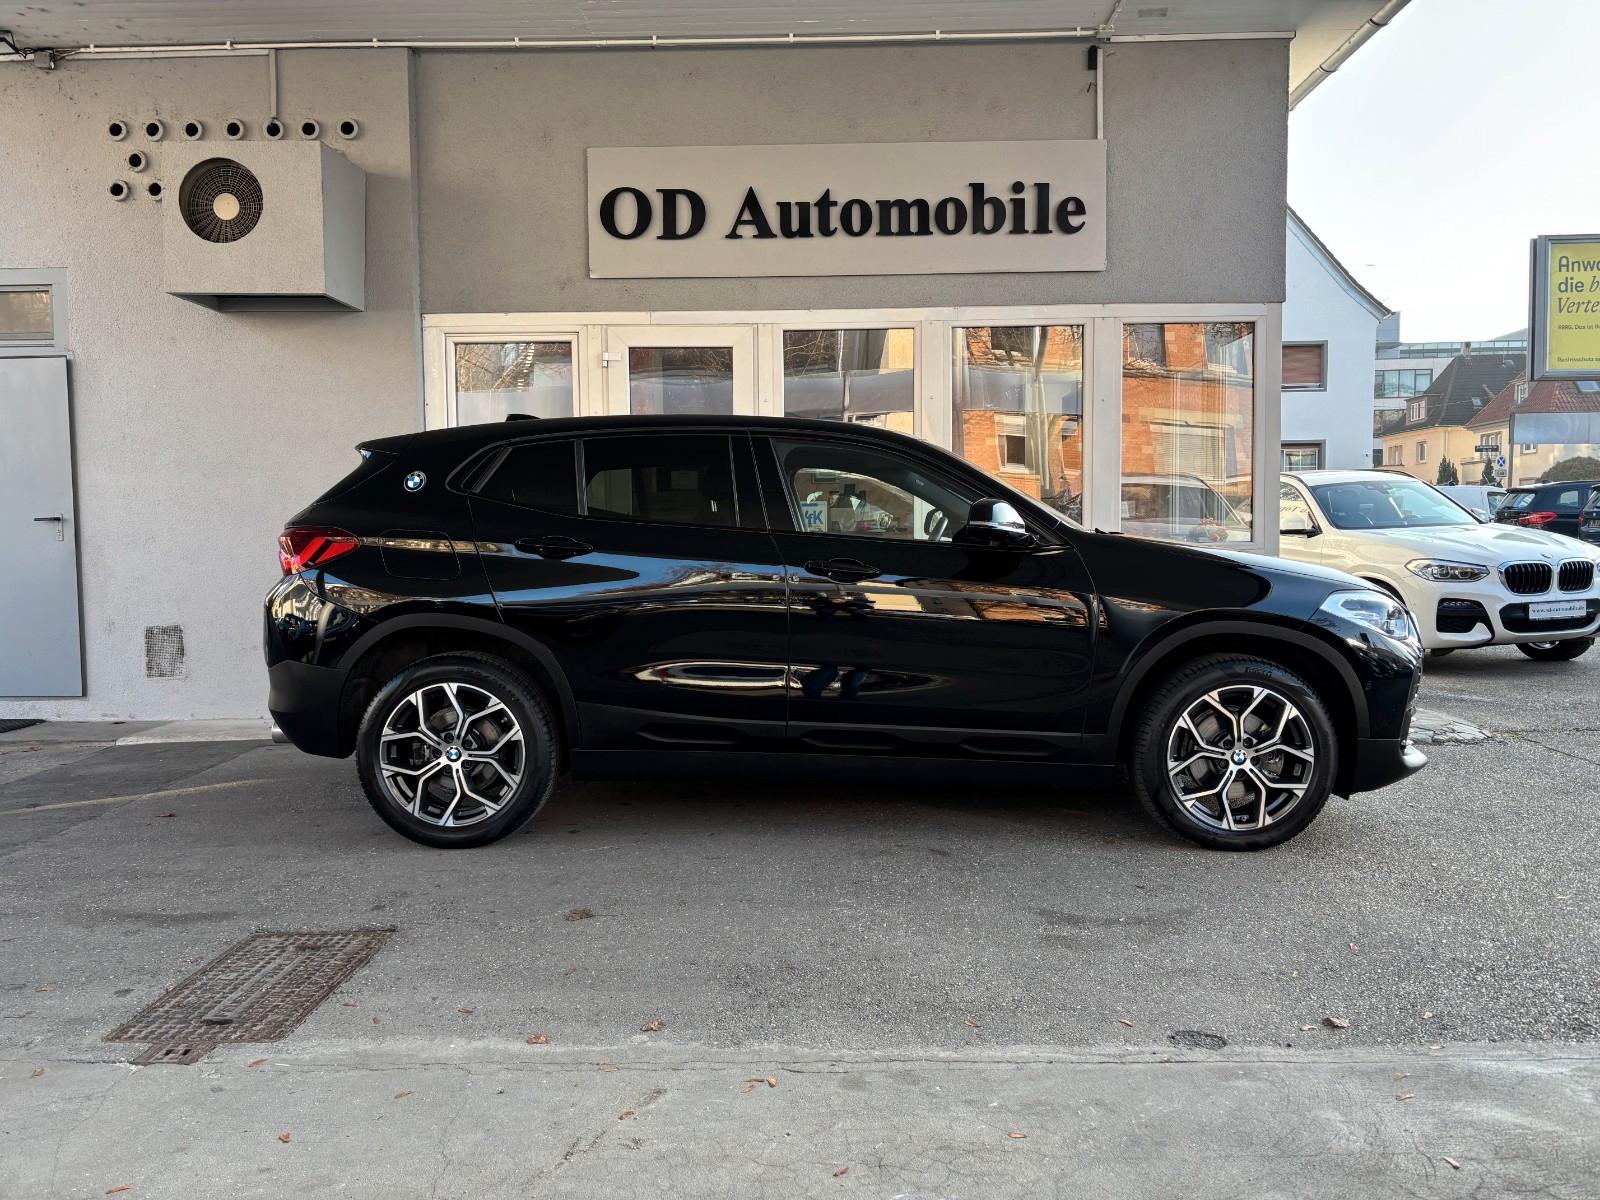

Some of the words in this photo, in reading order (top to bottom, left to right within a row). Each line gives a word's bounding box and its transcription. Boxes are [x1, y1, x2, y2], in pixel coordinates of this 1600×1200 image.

[600, 186, 706, 239] OD
[725, 180, 1087, 239] Automobile
[1558, 276, 1585, 293] die
[1588, 275, 1600, 293] b
[1558, 297, 1600, 314] Verte
